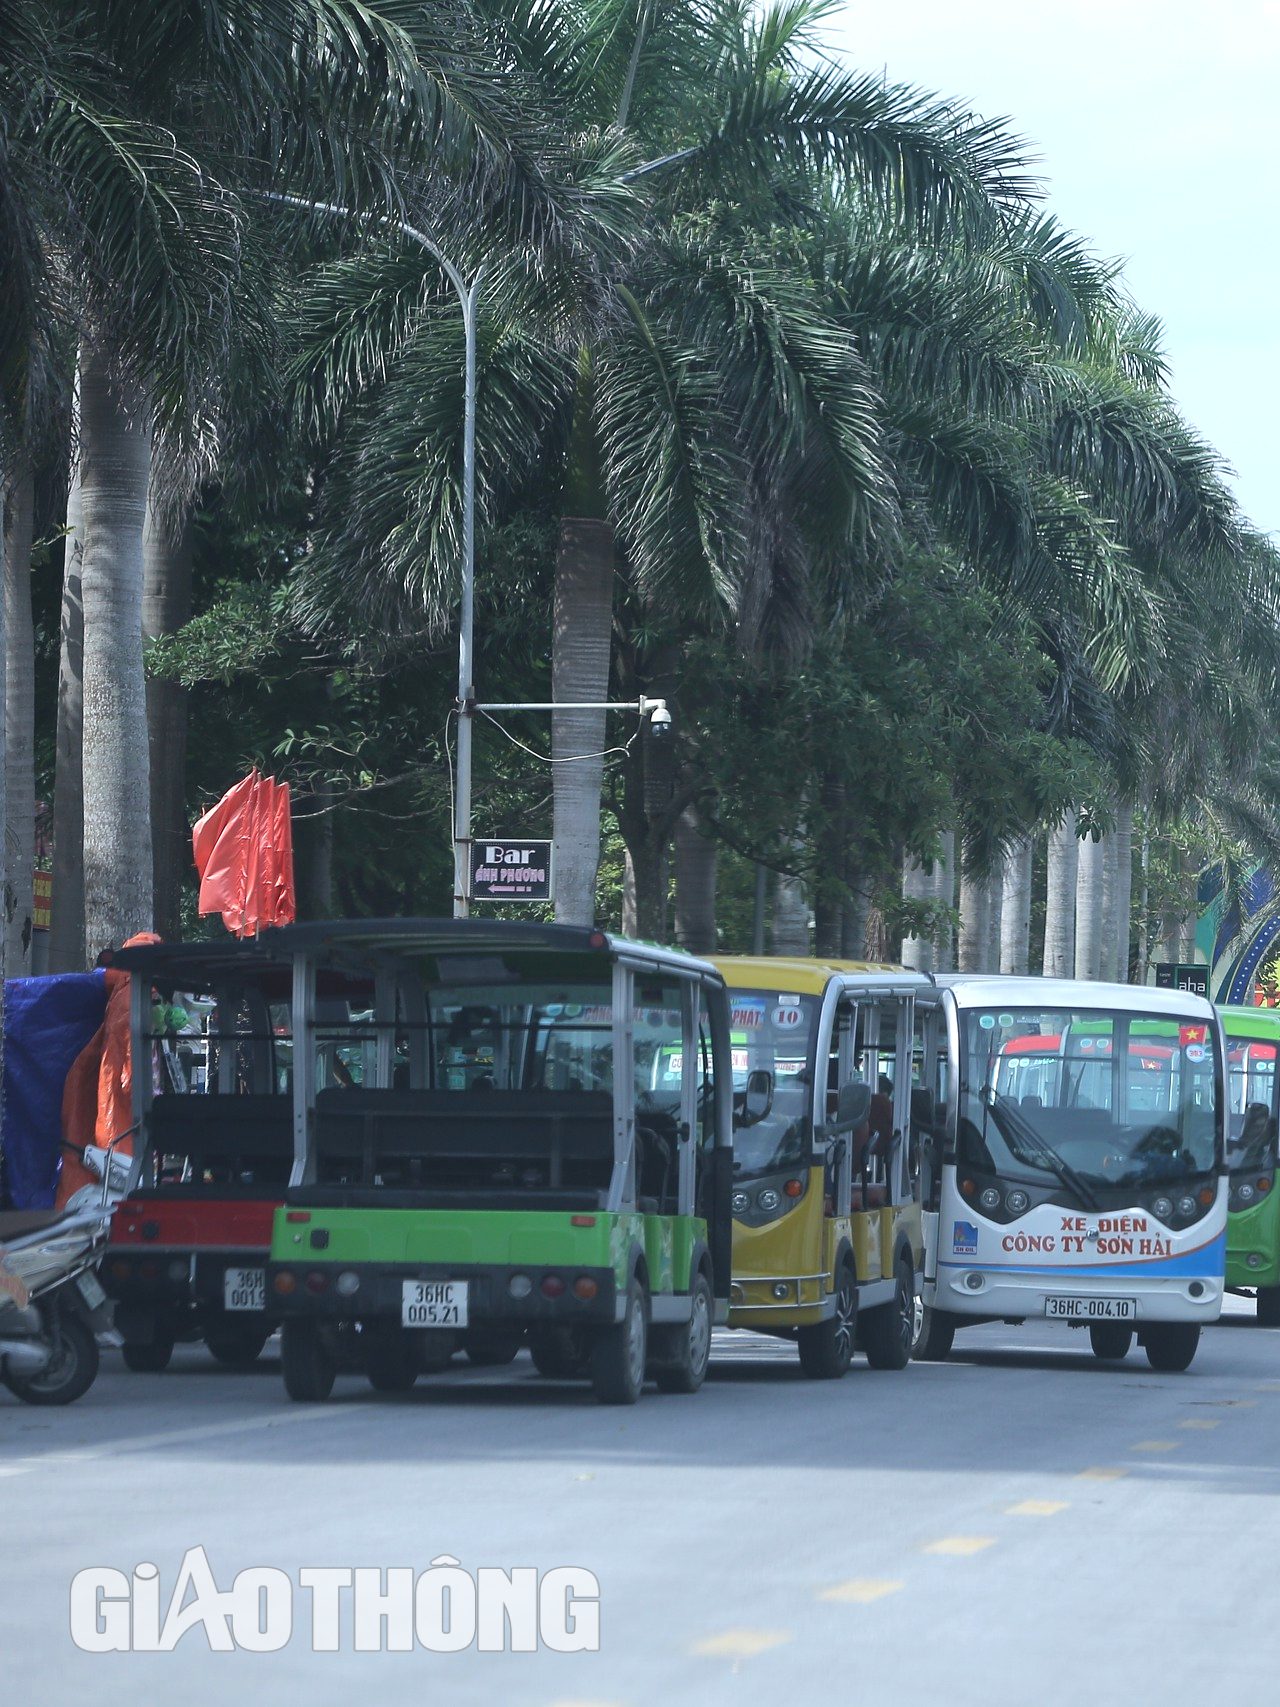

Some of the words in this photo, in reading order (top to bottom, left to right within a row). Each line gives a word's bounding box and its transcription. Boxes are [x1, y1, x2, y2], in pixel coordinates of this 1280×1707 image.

[486, 846, 536, 864] Bar
[1179, 976, 1206, 992] aha
[777, 1010, 798, 1025] 10
[1061, 1217, 1087, 1231] XE
[1098, 1215, 1148, 1235] ĐIỆN
[1001, 1231, 1056, 1252] CÔNG
[1061, 1236, 1088, 1252] TY
[1096, 1235, 1134, 1255] SƠN
[1139, 1232, 1172, 1256] HẢI
[415, 1285, 454, 1304] 36HC
[408, 1305, 459, 1324] 005.21
[1049, 1300, 1130, 1317] 36HC-004.10
